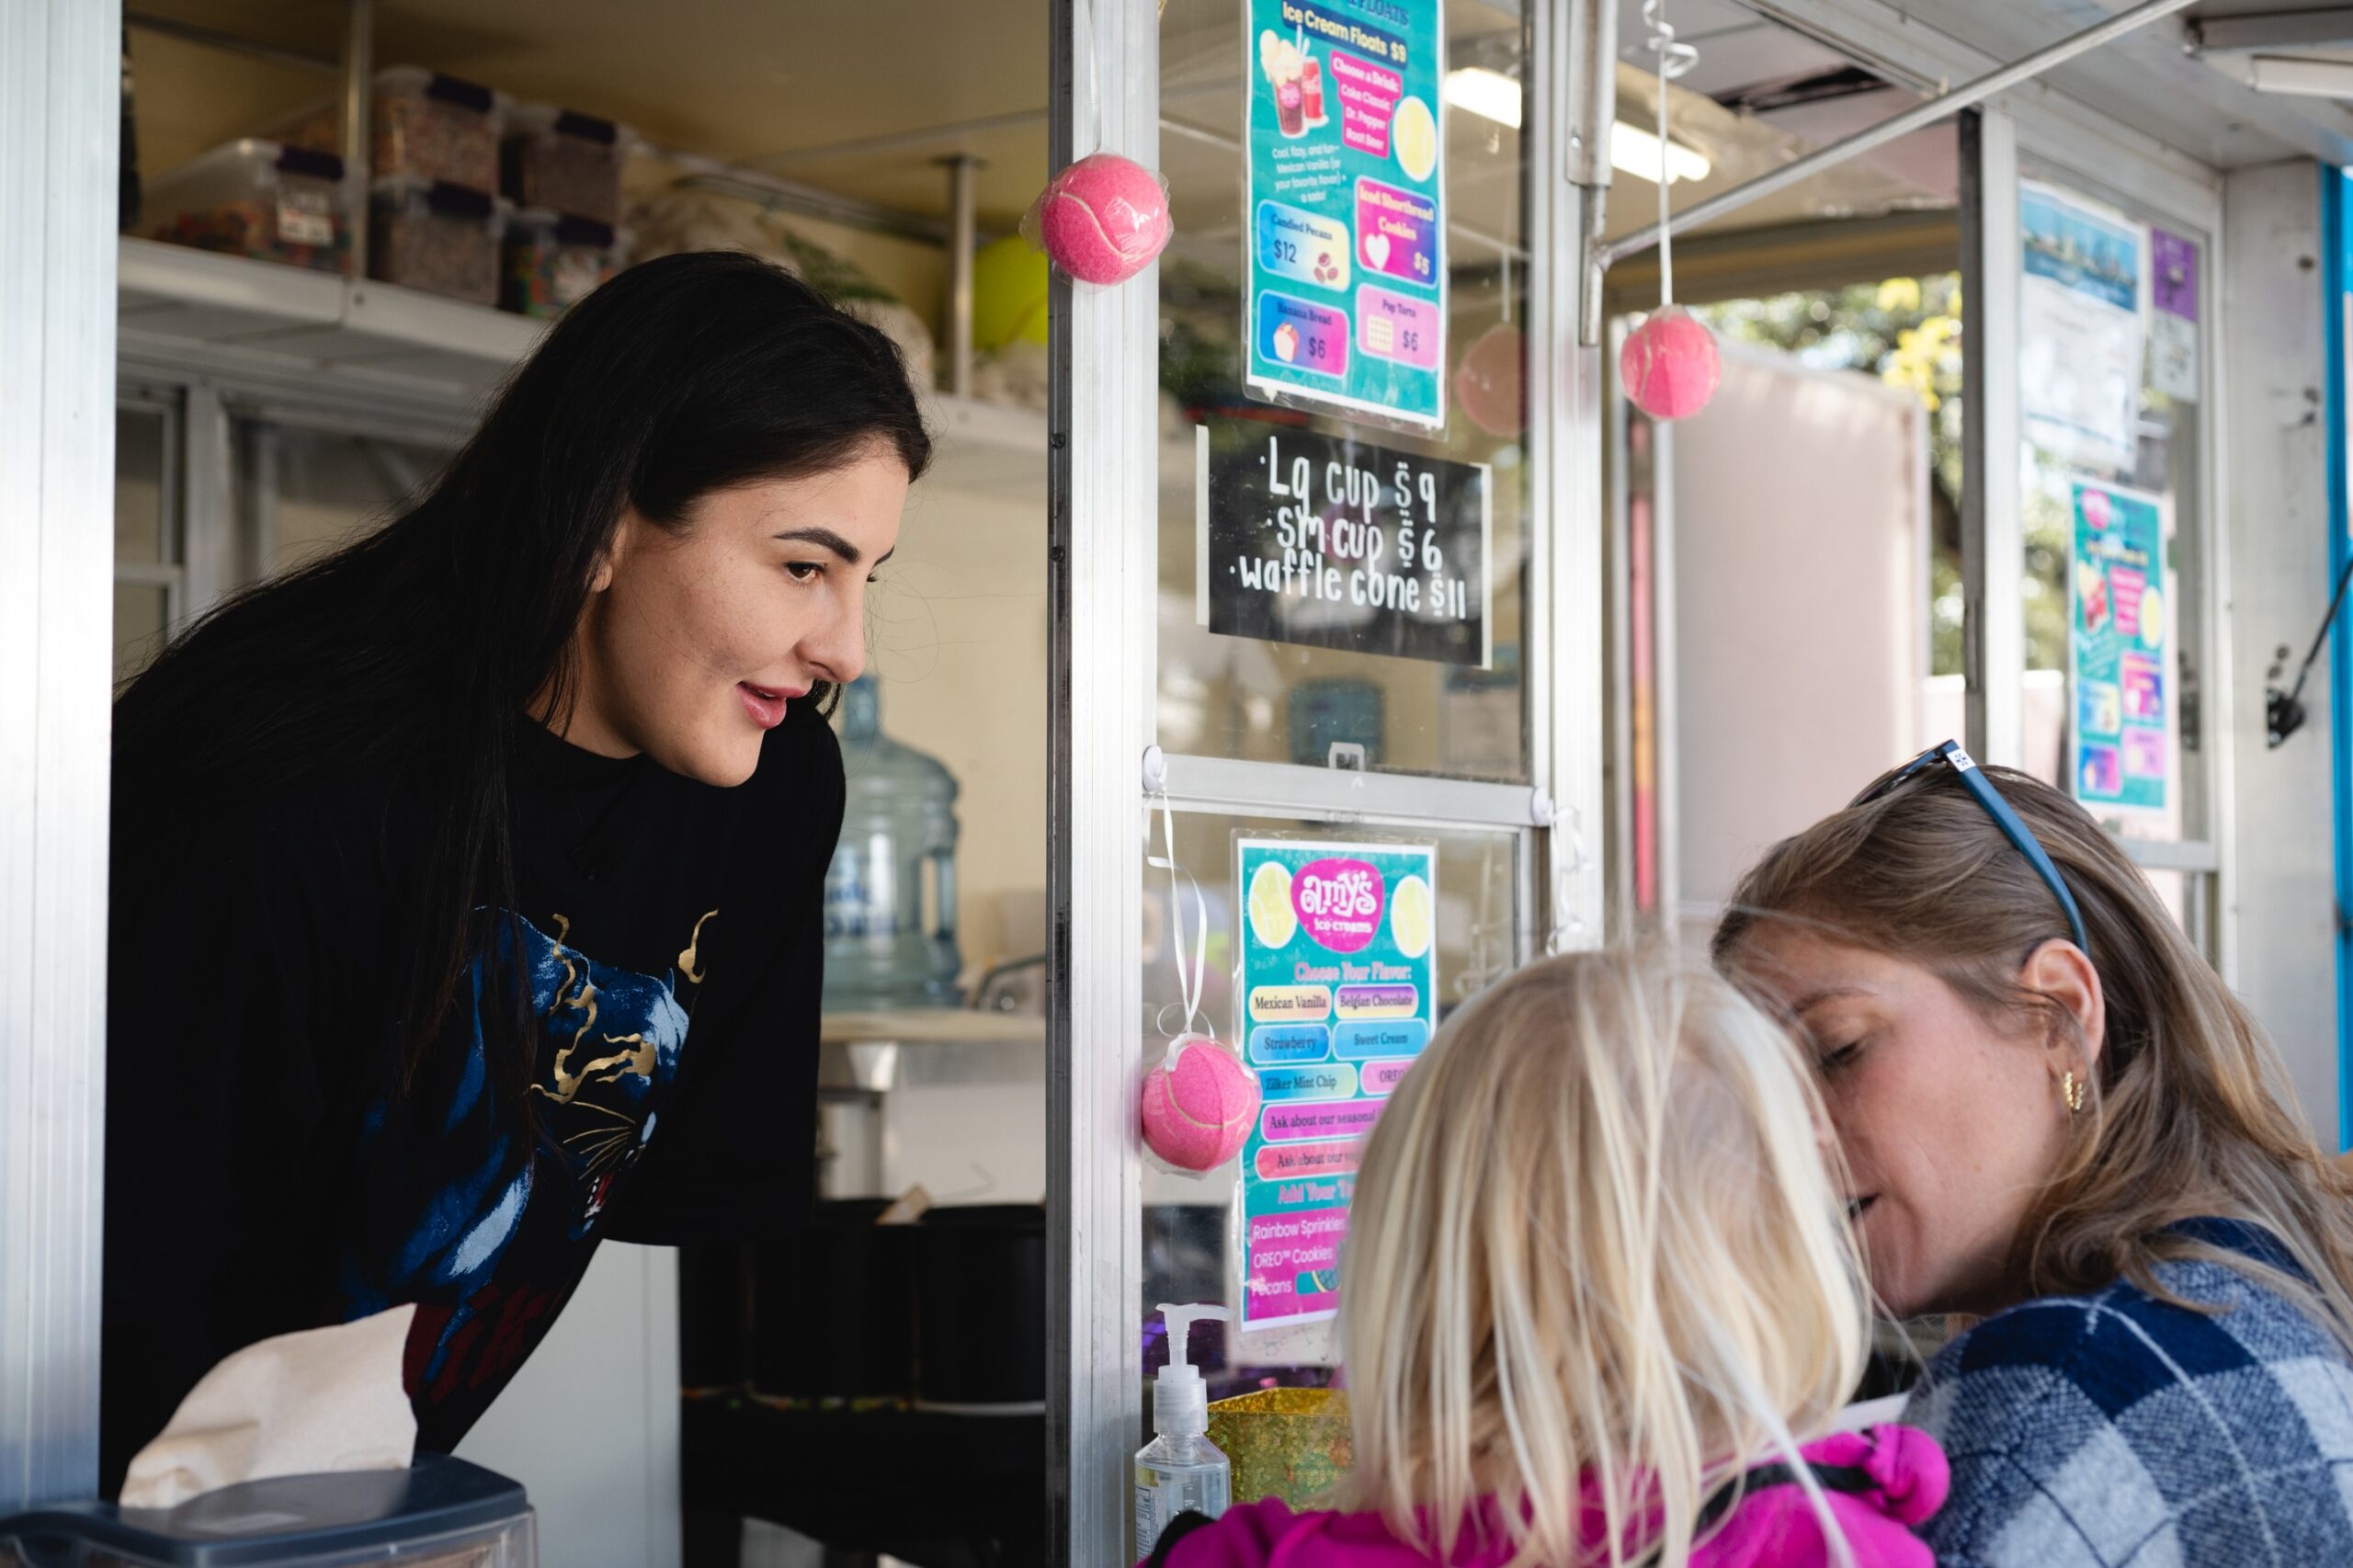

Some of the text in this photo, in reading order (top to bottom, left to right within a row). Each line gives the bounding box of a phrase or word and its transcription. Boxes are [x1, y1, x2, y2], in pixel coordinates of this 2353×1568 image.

[1282, 1, 1407, 63] Ice Cream Floats $9
[1333, 57, 1366, 81] Choose
[1341, 84, 1362, 102] Coke
[1362, 91, 1392, 112] Classic
[1358, 109, 1386, 131] Pepper
[1308, 144, 1324, 155] and
[1345, 127, 1385, 151] Root Beer
[1276, 161, 1305, 174] Mexican
[1305, 159, 1330, 172] Vanilla
[1275, 179, 1290, 194] your
[1291, 176, 1318, 188] favorite
[1359, 185, 1434, 222] Iced Shortbread
[1271, 213, 1333, 241] Candied Pecans
[1378, 216, 1417, 242] Cookies
[1274, 238, 1297, 264] $12
[1277, 301, 1333, 326] Banana Bread
[1382, 299, 1416, 319] Pop Tarts
[1308, 335, 1326, 359] $6
[1402, 328, 1419, 352] $6
[1350, 568, 1421, 614] cone
[1429, 573, 1467, 620] $11
[1300, 869, 1377, 918] amy's
[1294, 960, 1413, 982] Choose Your Flavor:
[1255, 994, 1327, 1010] Mexican Vanilla
[1340, 994, 1413, 1011] Belgian Chocolate
[1264, 1036, 1318, 1051] Strawberry
[1354, 1031, 1409, 1047] Sweet Cream
[1266, 1074, 1337, 1091] Zilker Mint Chip
[1269, 1108, 1376, 1130] Ask about our seasonal
[1278, 1153, 1296, 1169] Ask
[1298, 1152, 1325, 1167] about
[1326, 1153, 1344, 1165] our
[1278, 1183, 1304, 1205] Add
[1305, 1181, 1336, 1202] Your
[1253, 1216, 1347, 1241] Rainbow Sprinkles
[1291, 1244, 1334, 1265] Cookies
[1251, 1278, 1293, 1297] Pecans
